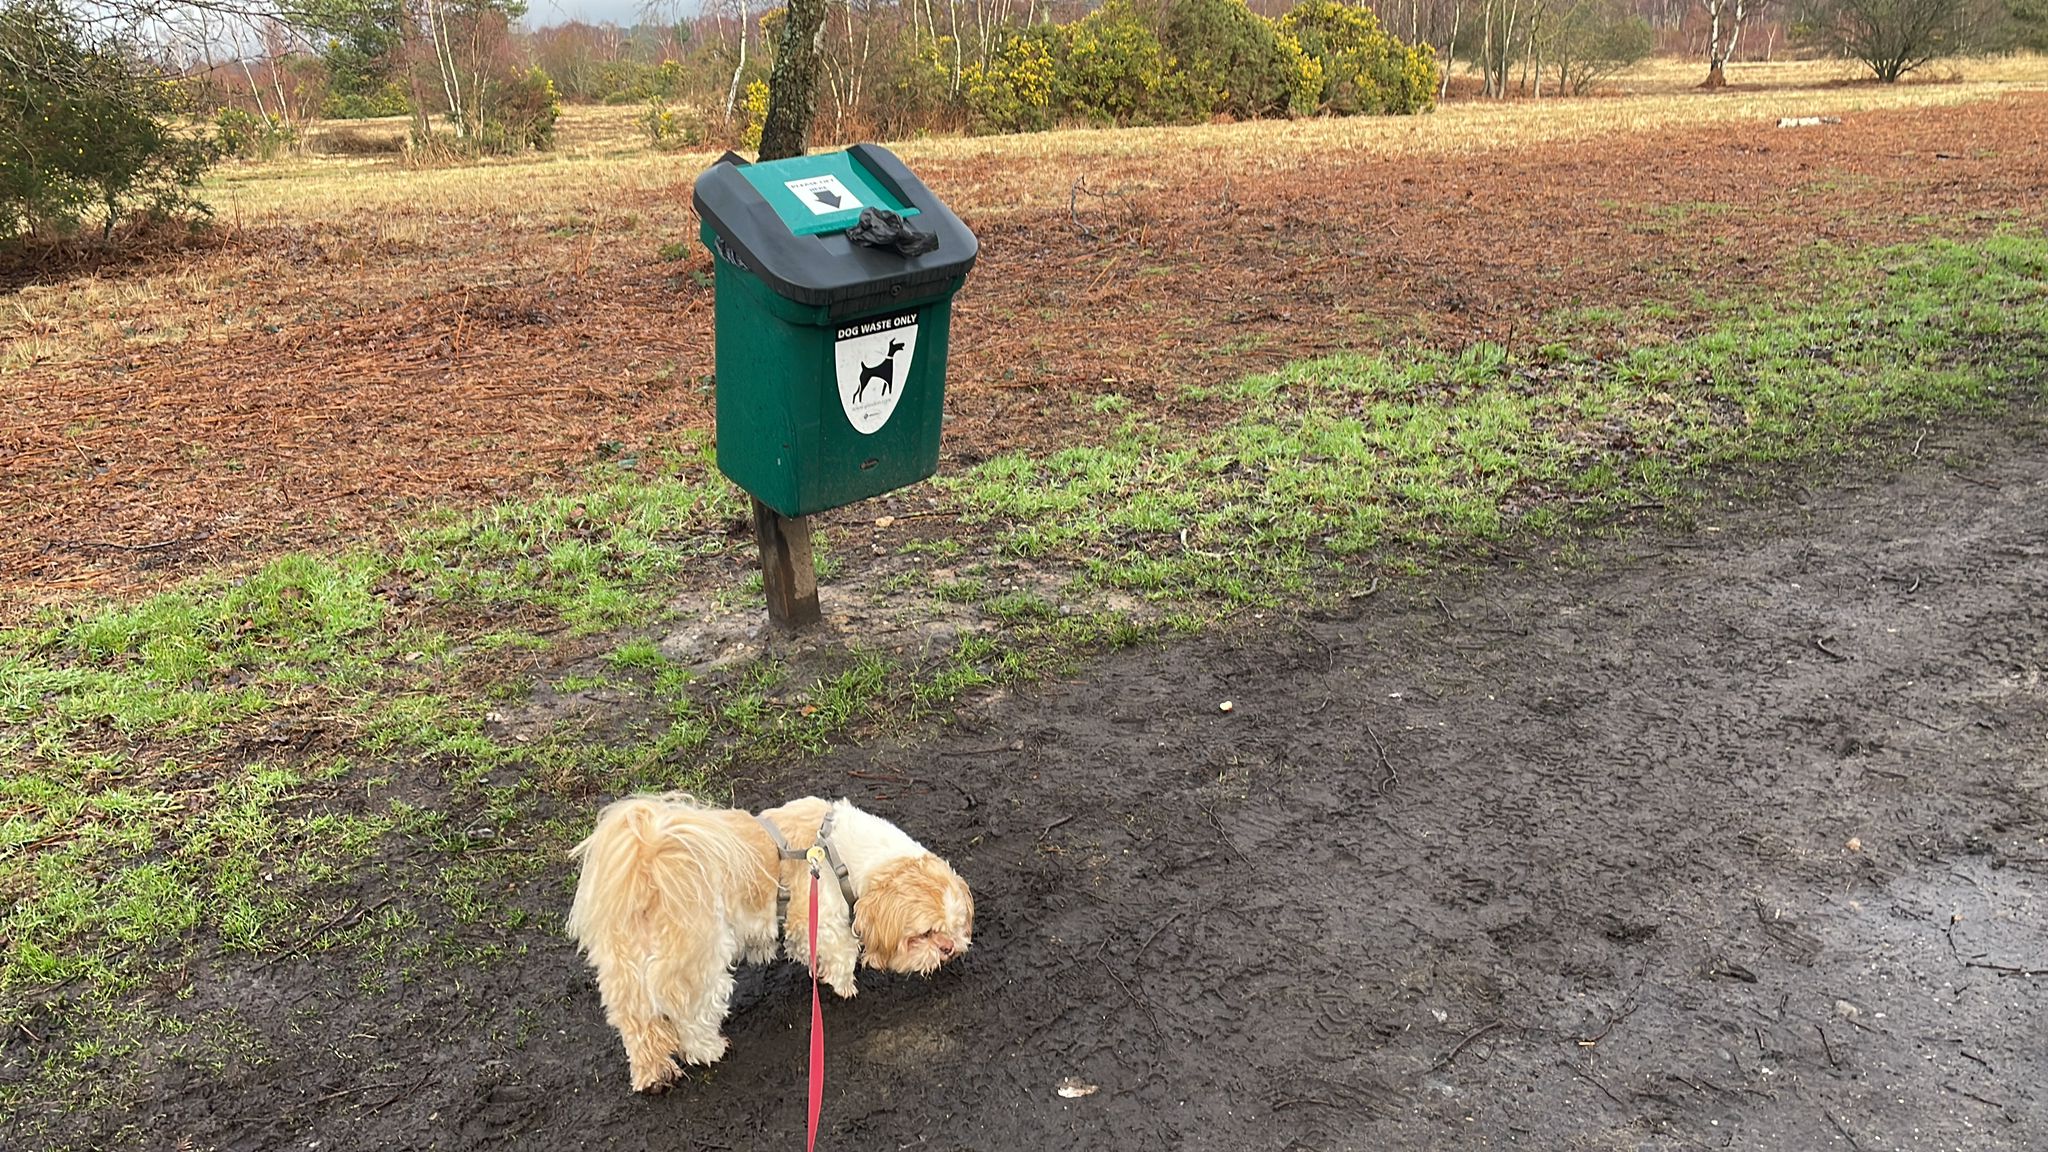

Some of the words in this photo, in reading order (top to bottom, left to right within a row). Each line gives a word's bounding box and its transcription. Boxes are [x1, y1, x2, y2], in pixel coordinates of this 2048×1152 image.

[838, 326, 859, 339] DOG
[861, 319, 892, 334] WASTE
[893, 313, 917, 327] ONLY
